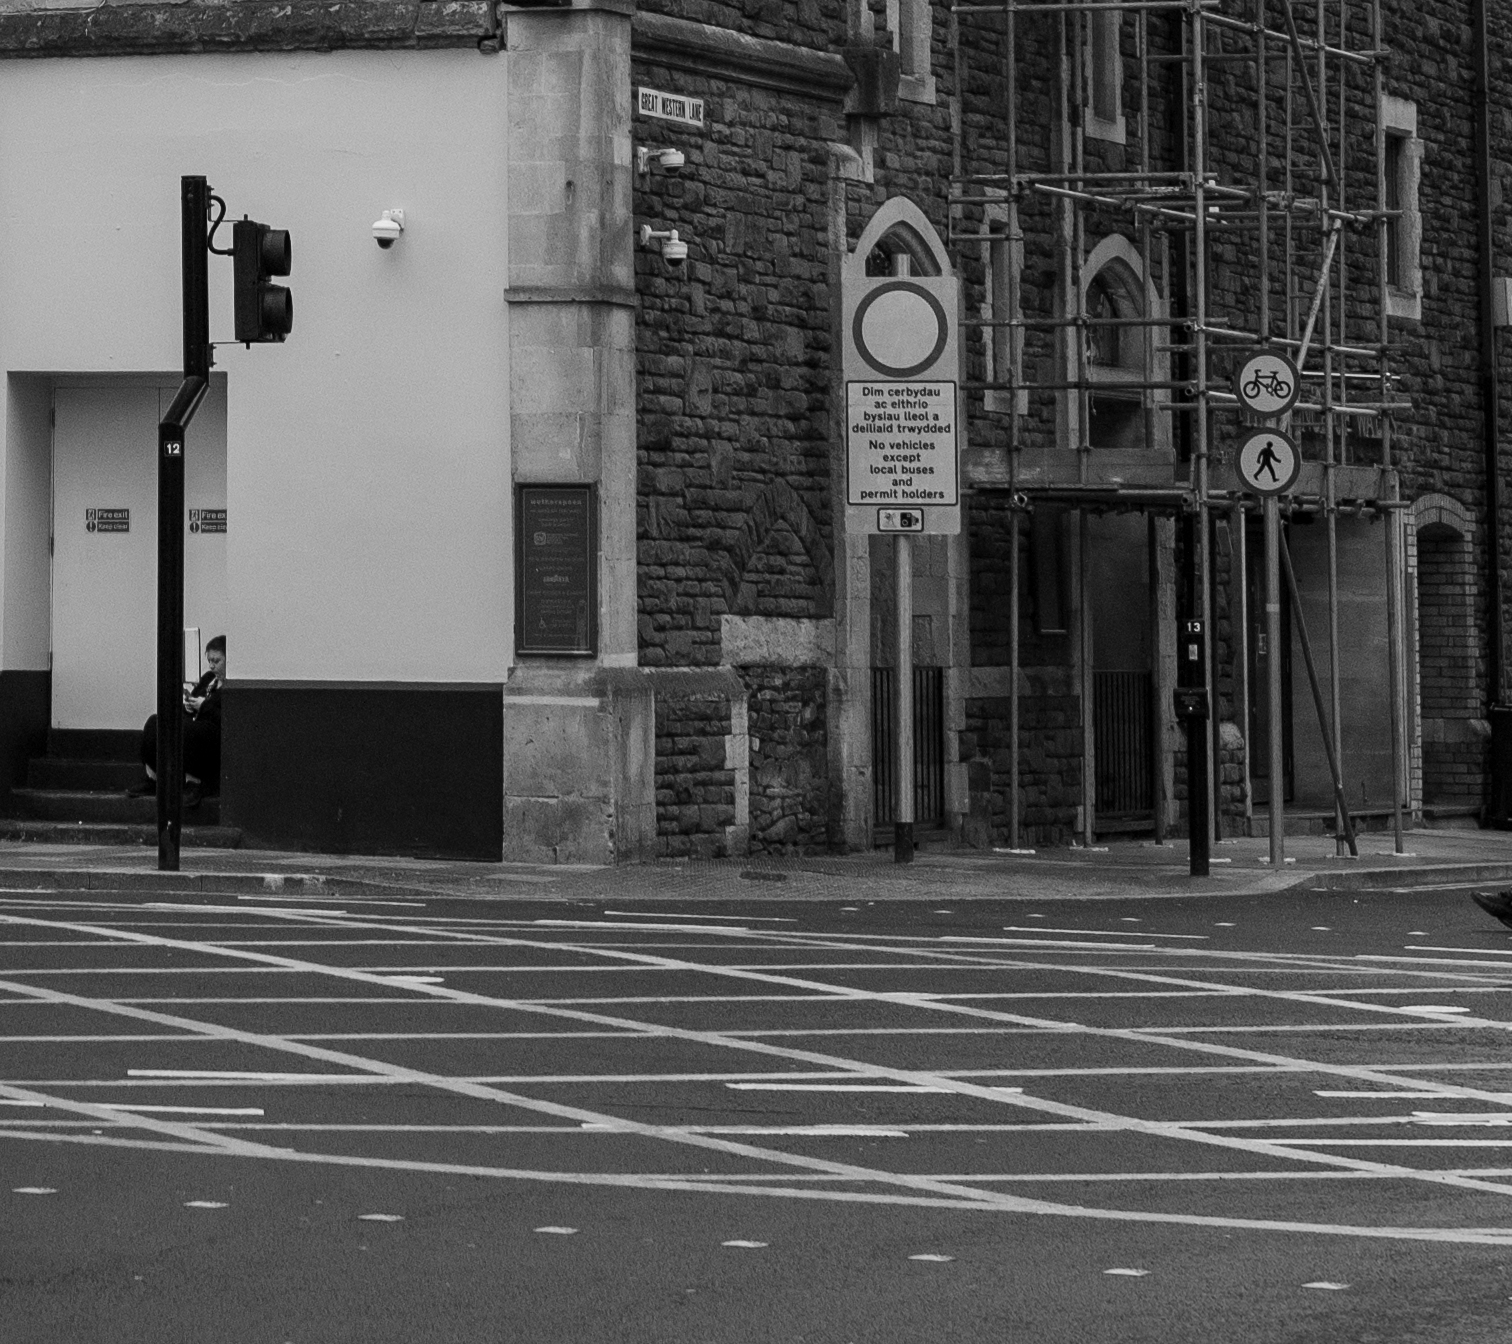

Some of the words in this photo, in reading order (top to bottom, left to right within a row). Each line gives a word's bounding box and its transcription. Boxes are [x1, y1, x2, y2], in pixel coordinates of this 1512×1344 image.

[642, 92, 658, 113] GREAT
[662, 97, 685, 119] WESTERN
[689, 102, 702, 122] LANE
[863, 387, 883, 396] Dim
[888, 387, 940, 398] cerbydau
[874, 401, 887, 409] ac
[891, 399, 928, 409] eithrio
[864, 412, 900, 422] bysiau
[904, 412, 929, 421] lleol
[933, 413, 939, 421] a
[852, 424, 893, 433] deiliaid
[897, 424, 950, 434] trwydded
[167, 444, 180, 454] 12
[869, 440, 885, 449] No
[889, 440, 935, 449] vehicles
[883, 453, 921, 463] except
[870, 465, 897, 474] local
[902, 465, 934, 474] buses
[892, 477, 912, 486] and
[861, 489, 898, 500] permit
[902, 489, 944, 499] holders
[202, 511, 216, 519] Fire
[1187, 622, 1200, 632] 13
